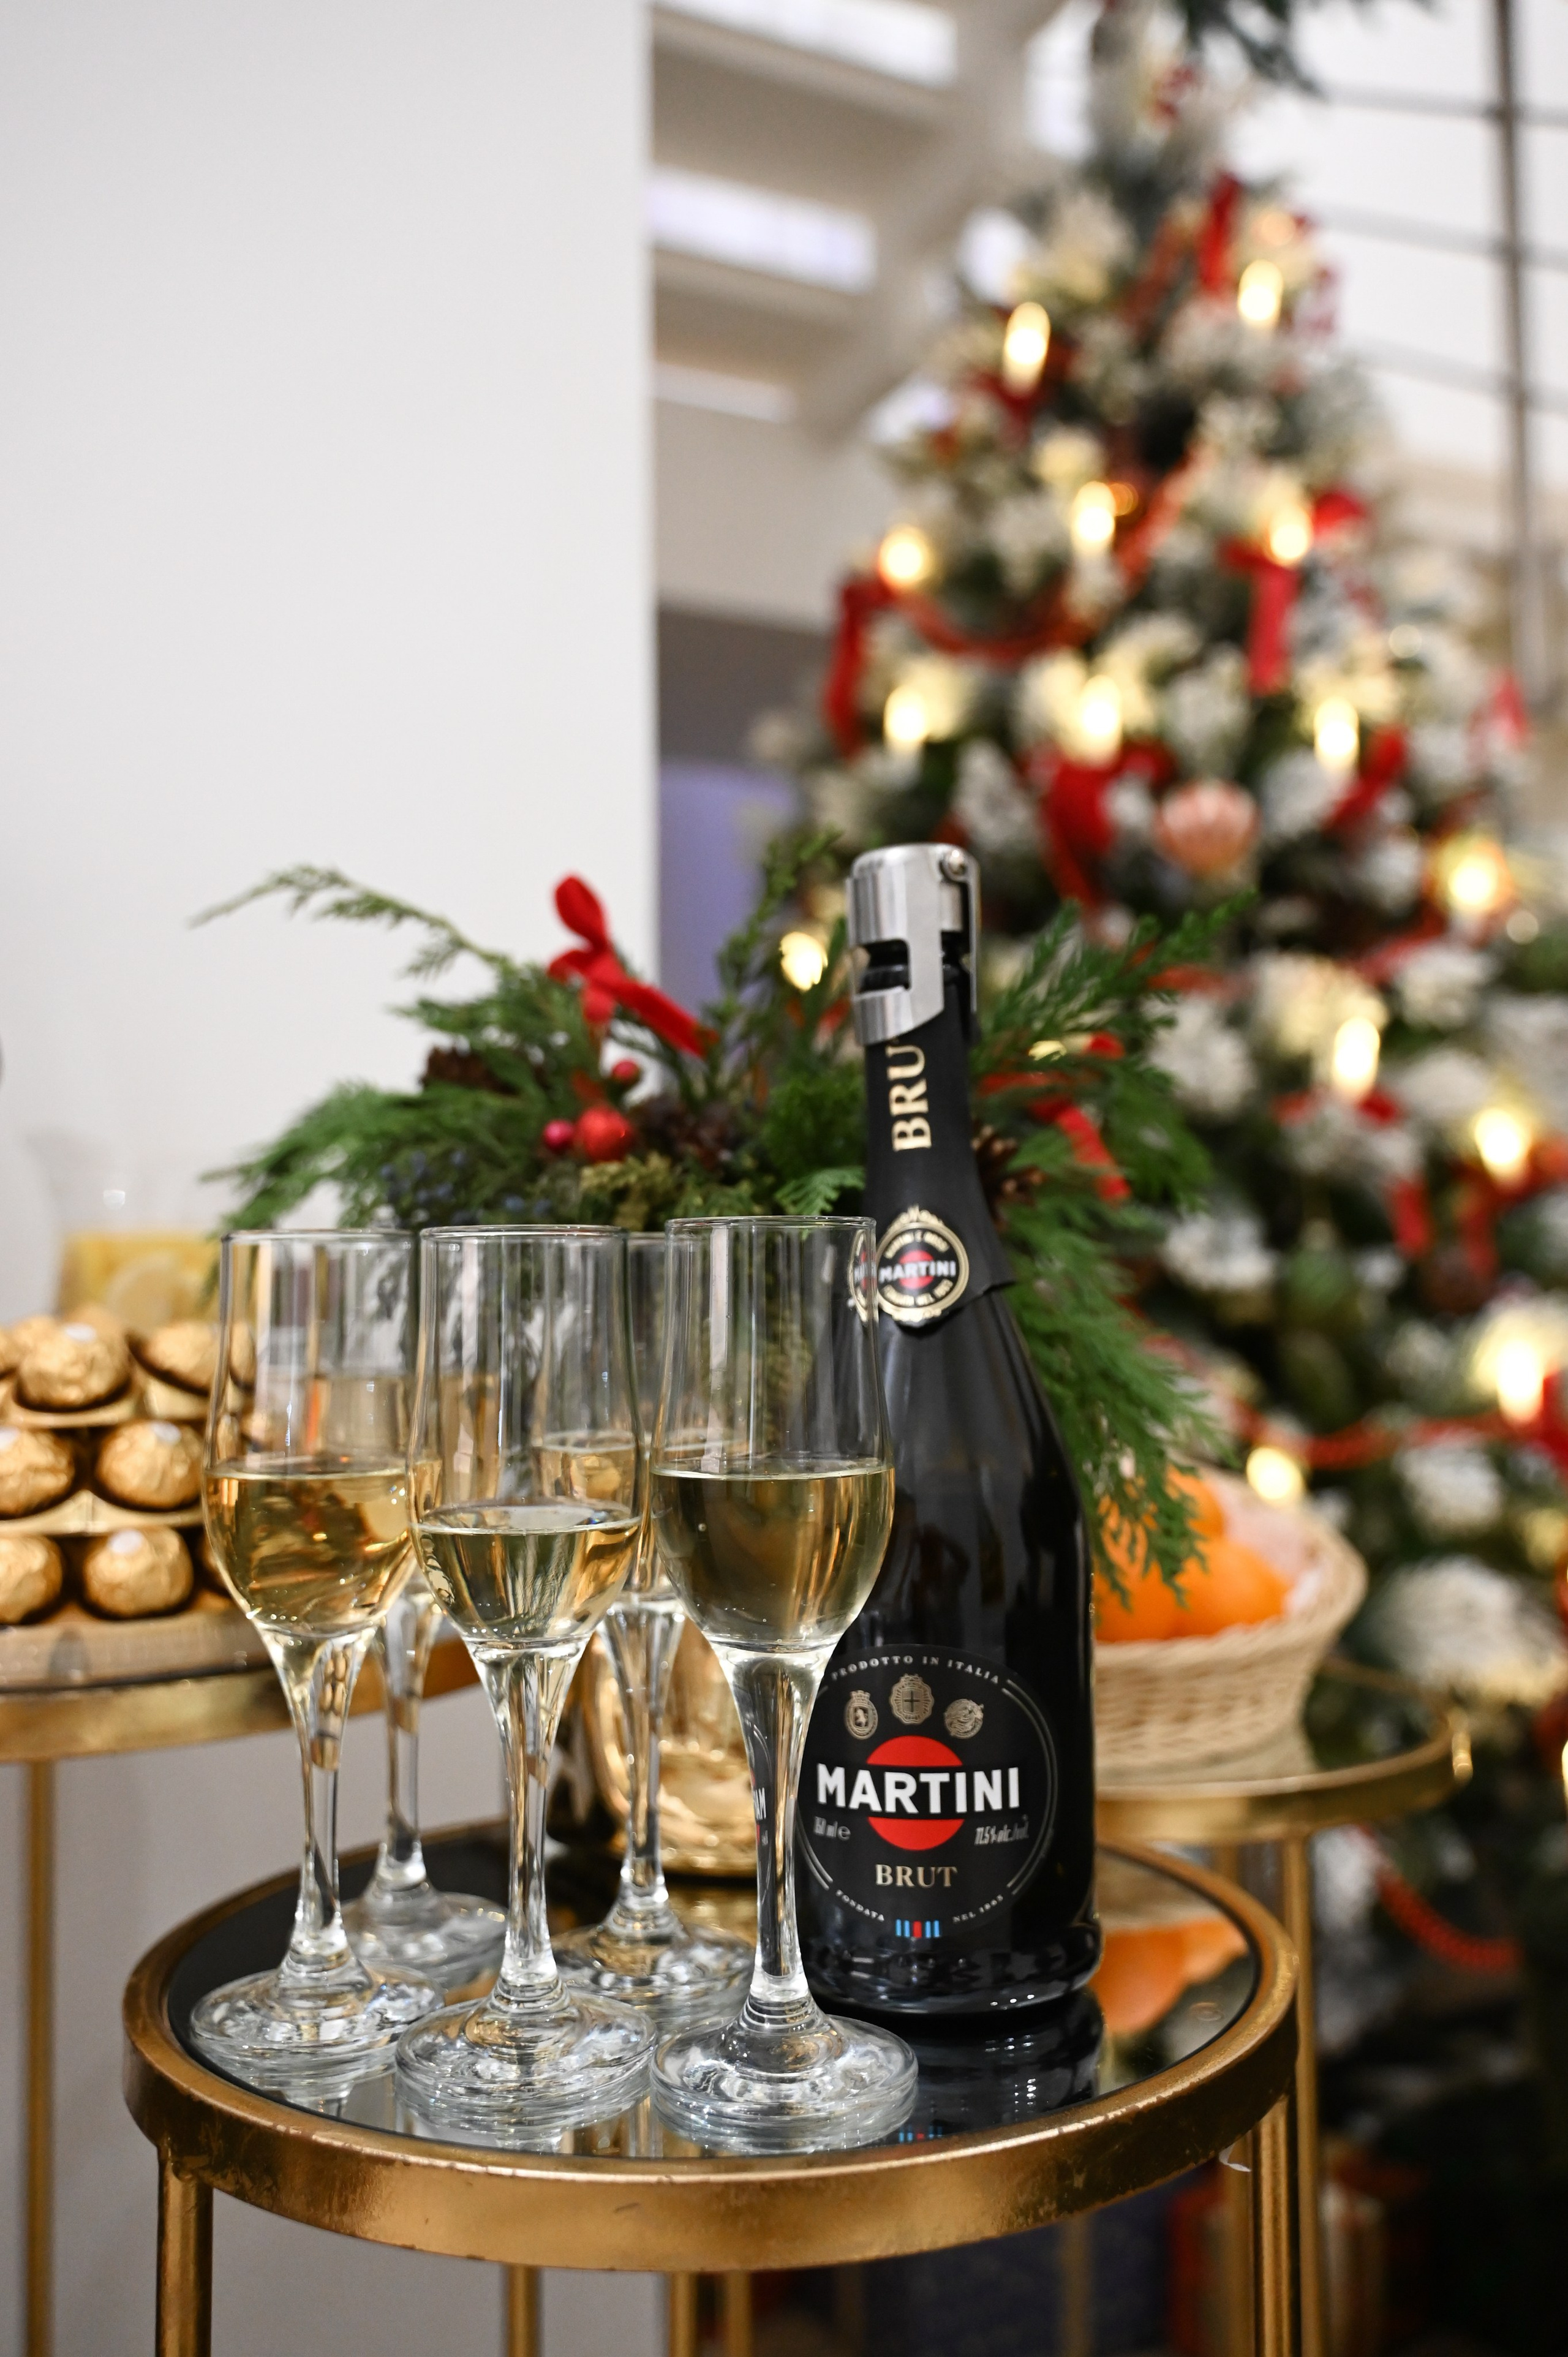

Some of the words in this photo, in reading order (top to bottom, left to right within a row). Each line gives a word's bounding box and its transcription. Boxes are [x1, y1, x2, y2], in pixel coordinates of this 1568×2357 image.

[885, 1039, 932, 1152] BRU
[878, 1260, 956, 1284] MARTINI
[831, 1655, 913, 1681] PRODOTTO
[922, 1656, 940, 1665] IN
[947, 1659, 999, 1684] ITALIA
[816, 1763, 1020, 1814] MARTINI
[875, 1864, 958, 1888] BRUT
